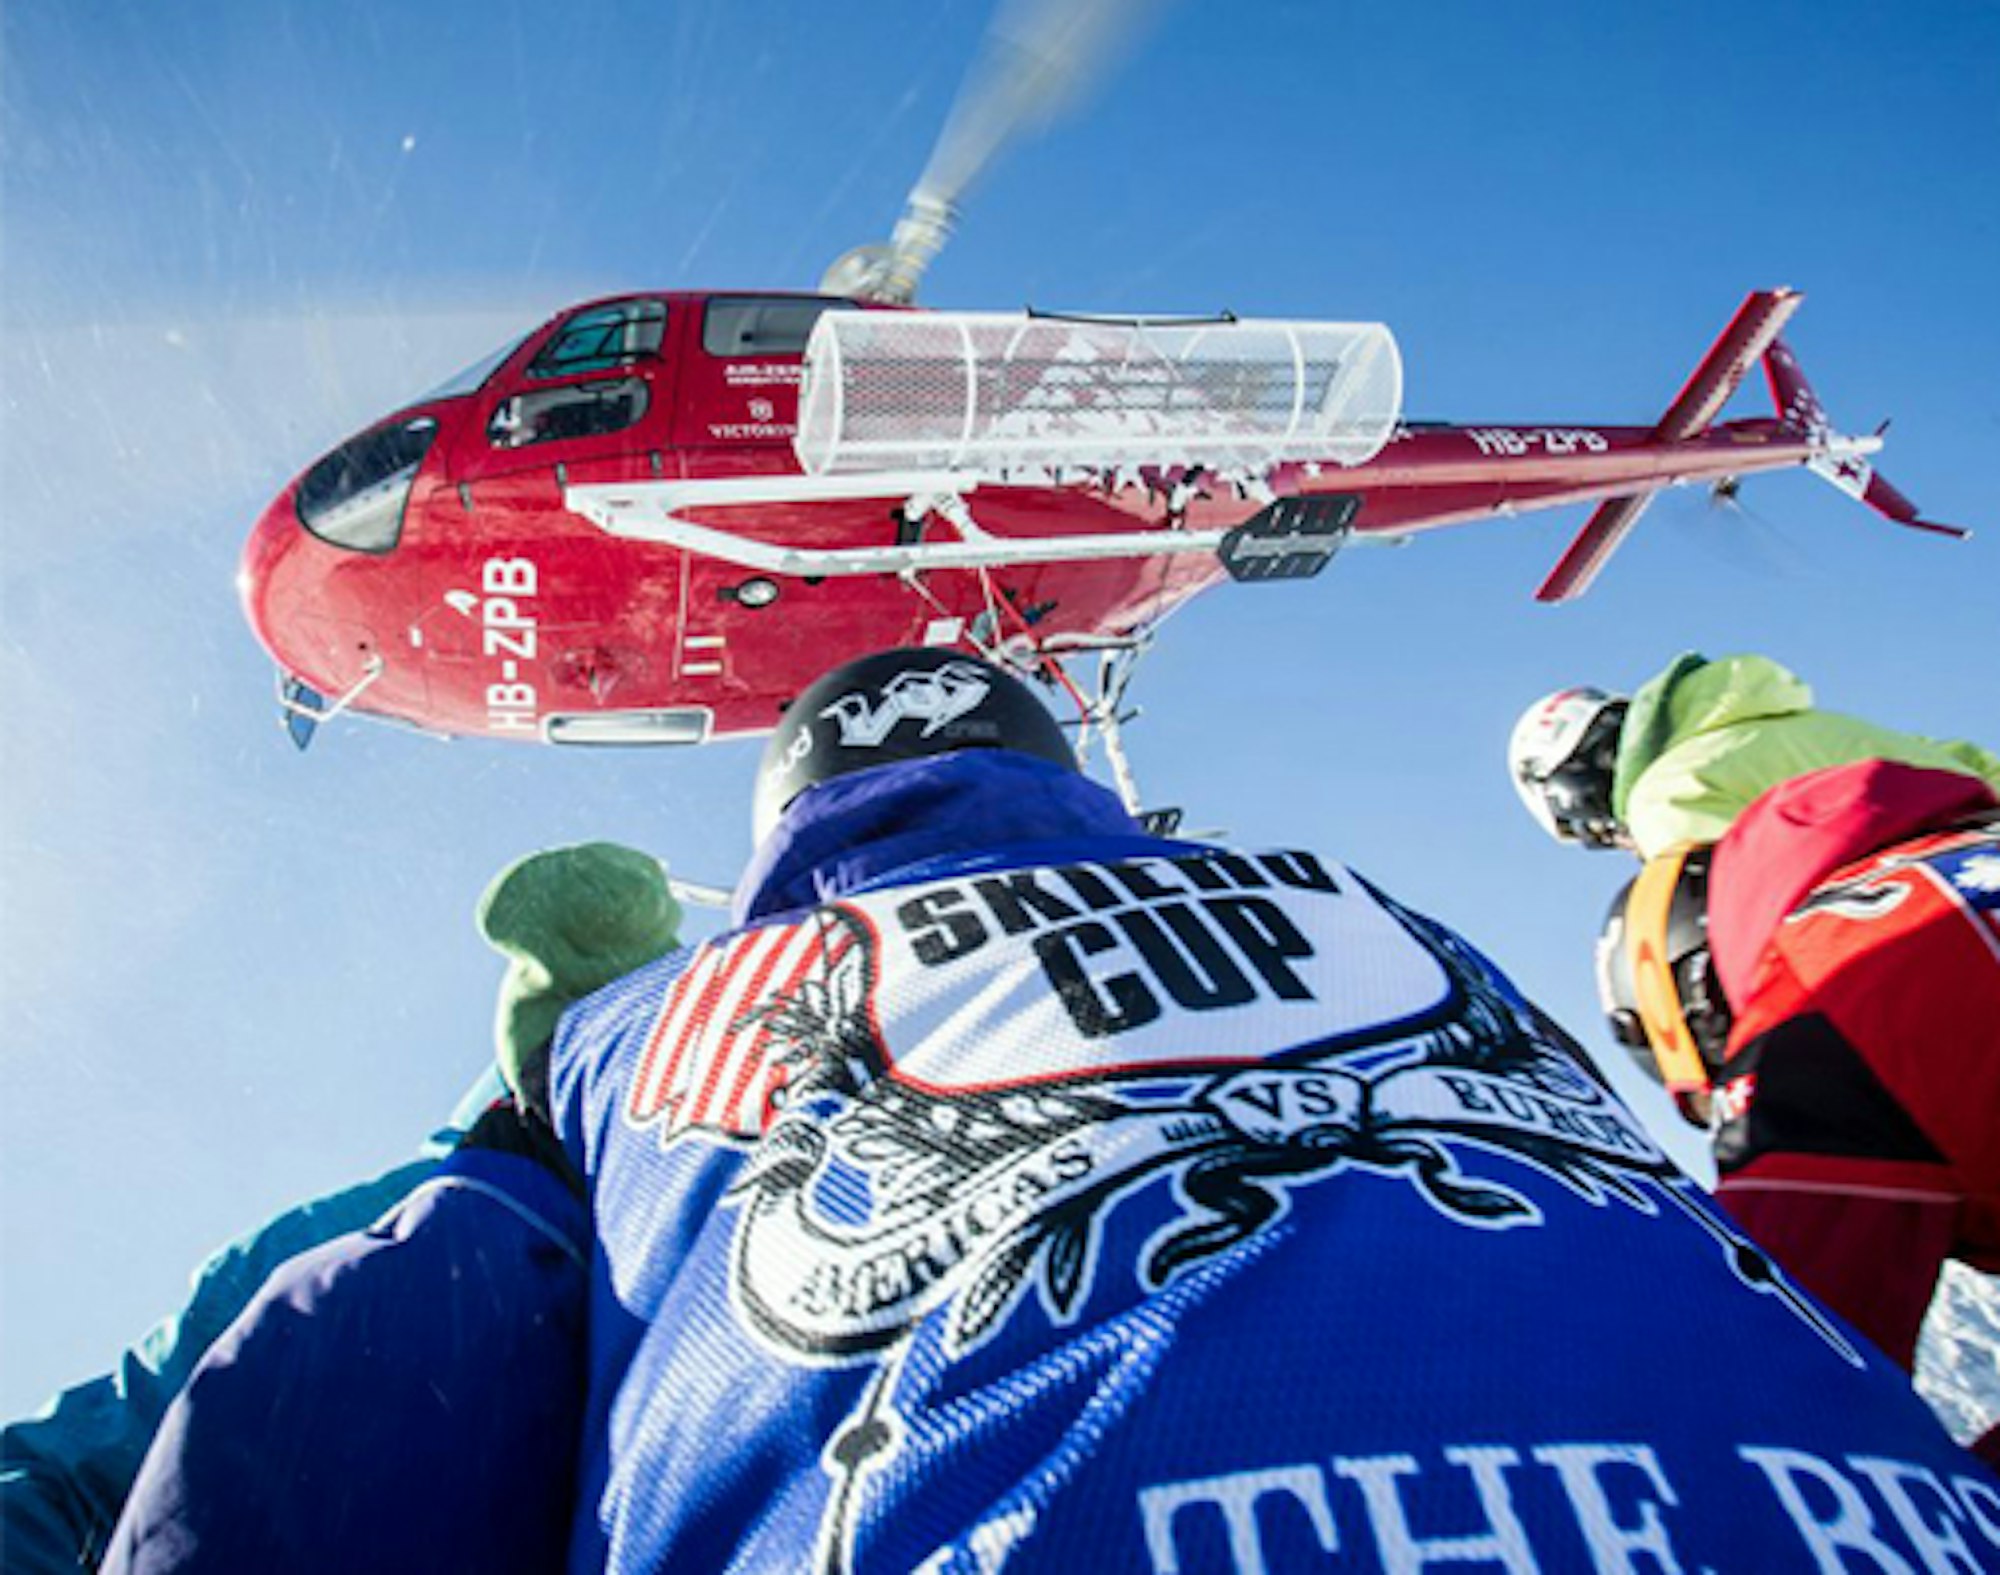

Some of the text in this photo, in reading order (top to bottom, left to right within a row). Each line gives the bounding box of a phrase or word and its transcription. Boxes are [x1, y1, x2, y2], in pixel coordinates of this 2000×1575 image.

[1467, 427, 1609, 455] HB-ZPB
[483, 556, 538, 731] HB-ZPB
[1031, 894, 1320, 1039] CUP
[1226, 1079, 1340, 1120] VS
[1136, 1444, 1720, 1575] THE
